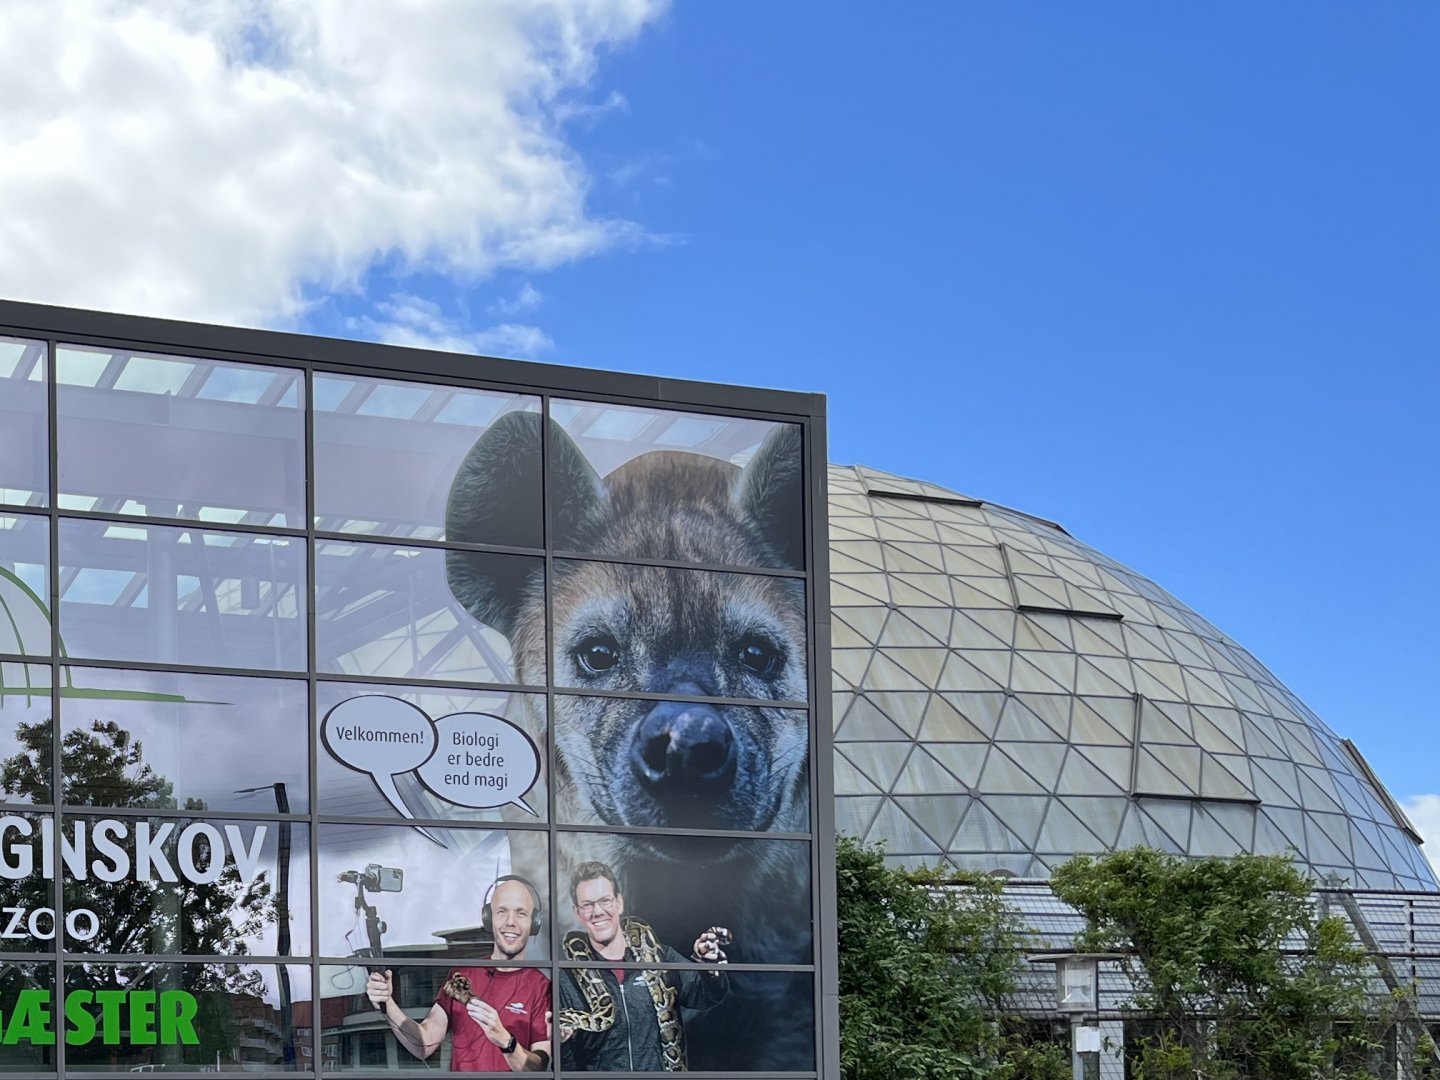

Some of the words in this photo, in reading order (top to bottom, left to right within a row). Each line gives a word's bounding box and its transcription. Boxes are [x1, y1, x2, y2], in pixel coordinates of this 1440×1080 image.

[336, 726, 424, 744] Velkommen!
[452, 731, 499, 750] Biologi
[447, 754, 461, 765] er
[466, 752, 504, 767] bedre
[444, 771, 469, 786] end
[474, 773, 508, 790] magi
[2, 907, 100, 941] ZOO
